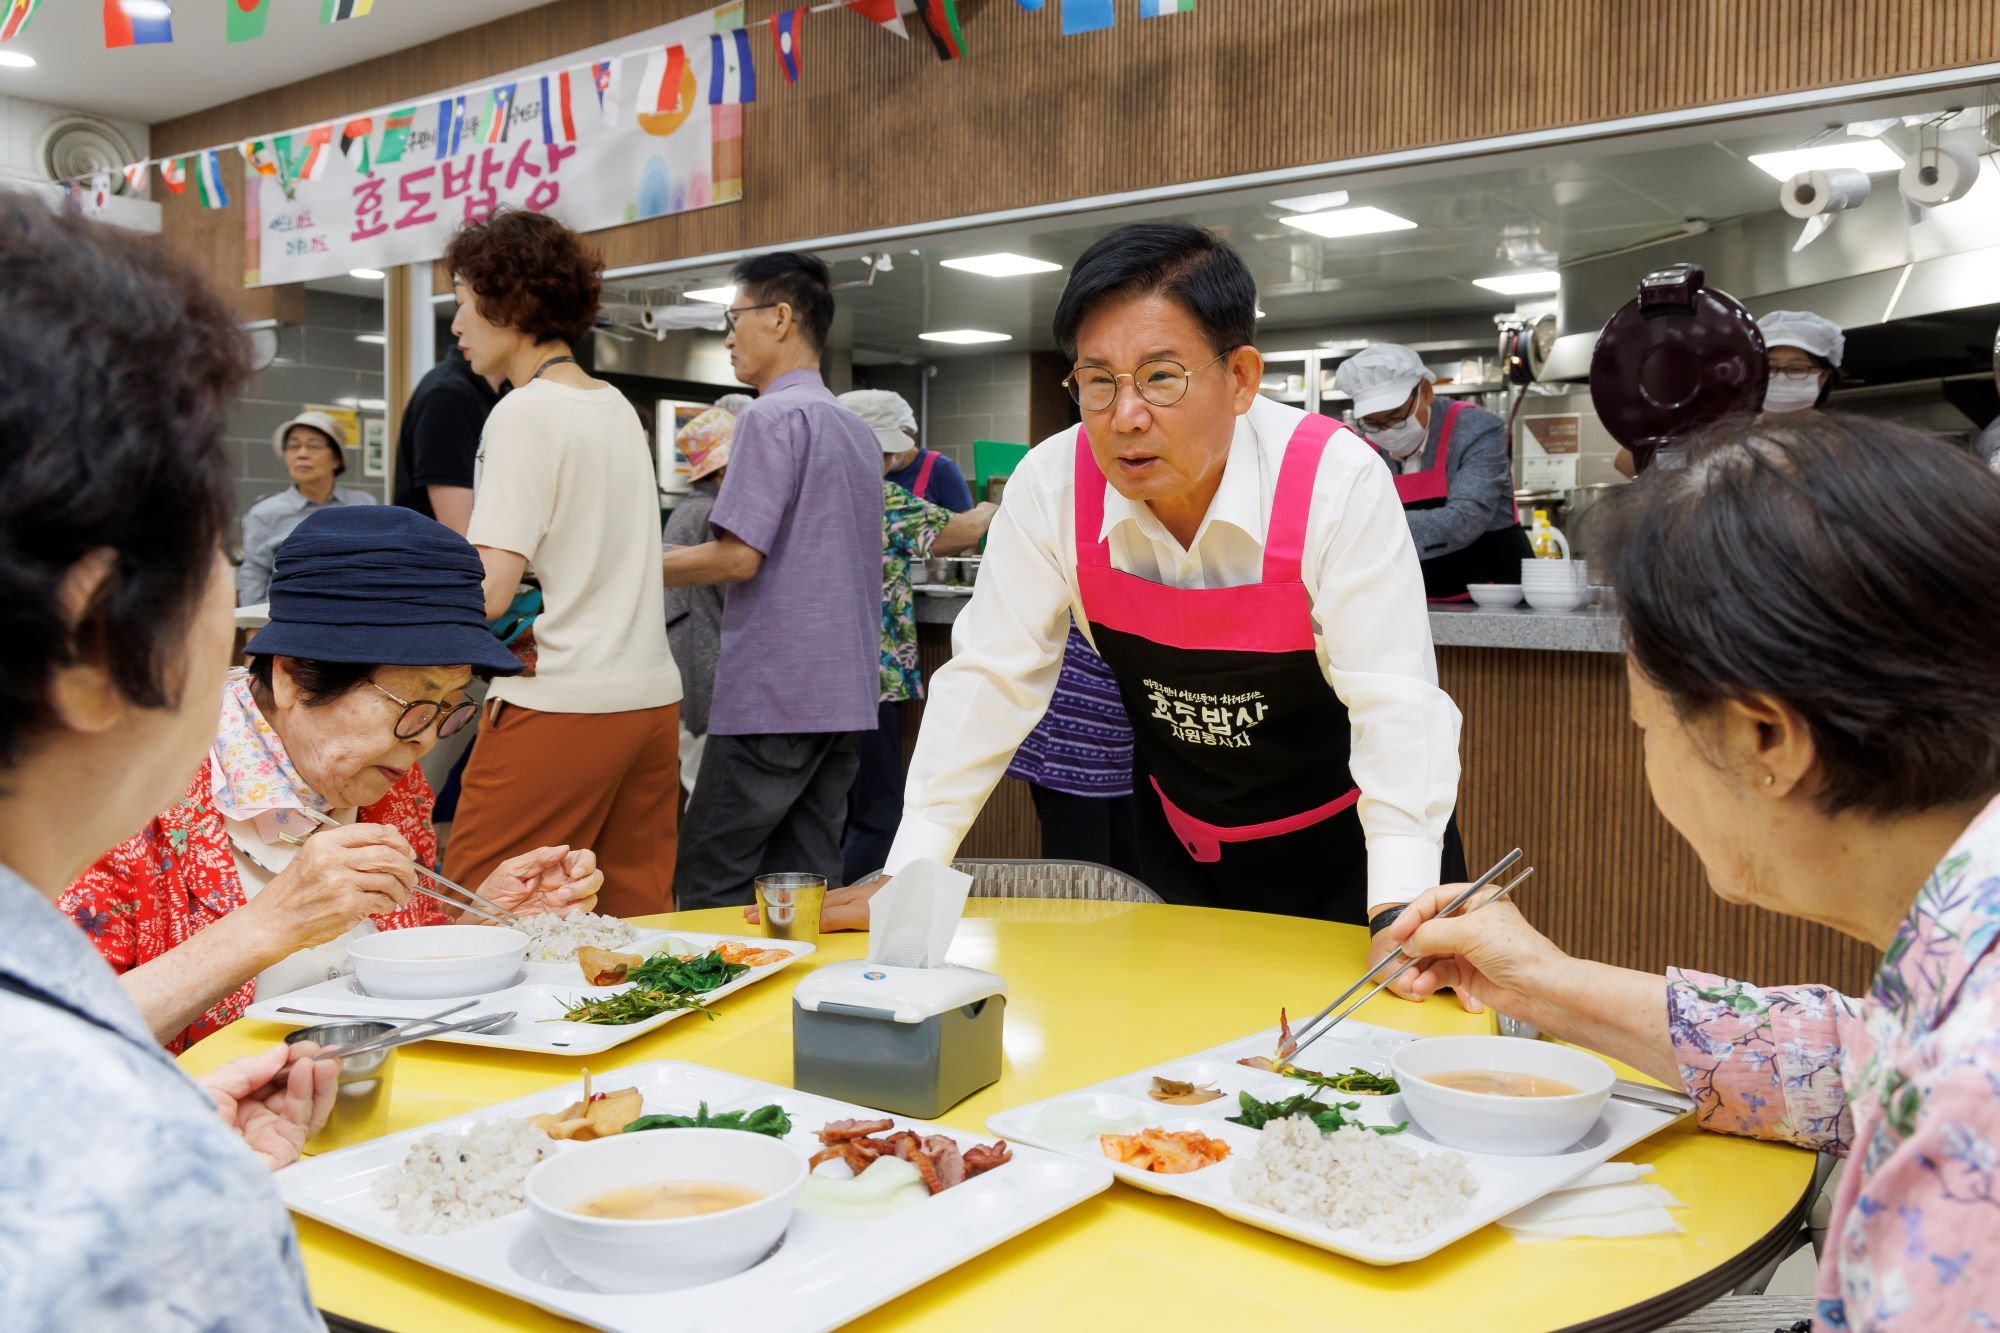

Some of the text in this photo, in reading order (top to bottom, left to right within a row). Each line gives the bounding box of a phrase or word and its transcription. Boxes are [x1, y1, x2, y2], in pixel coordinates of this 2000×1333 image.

[351, 138, 576, 243] 효도밥상
[1142, 678, 1178, 698] 마포구민이
[1178, 690, 1217, 705] 어르신들께
[1170, 723, 1252, 749] 자원봉사자
